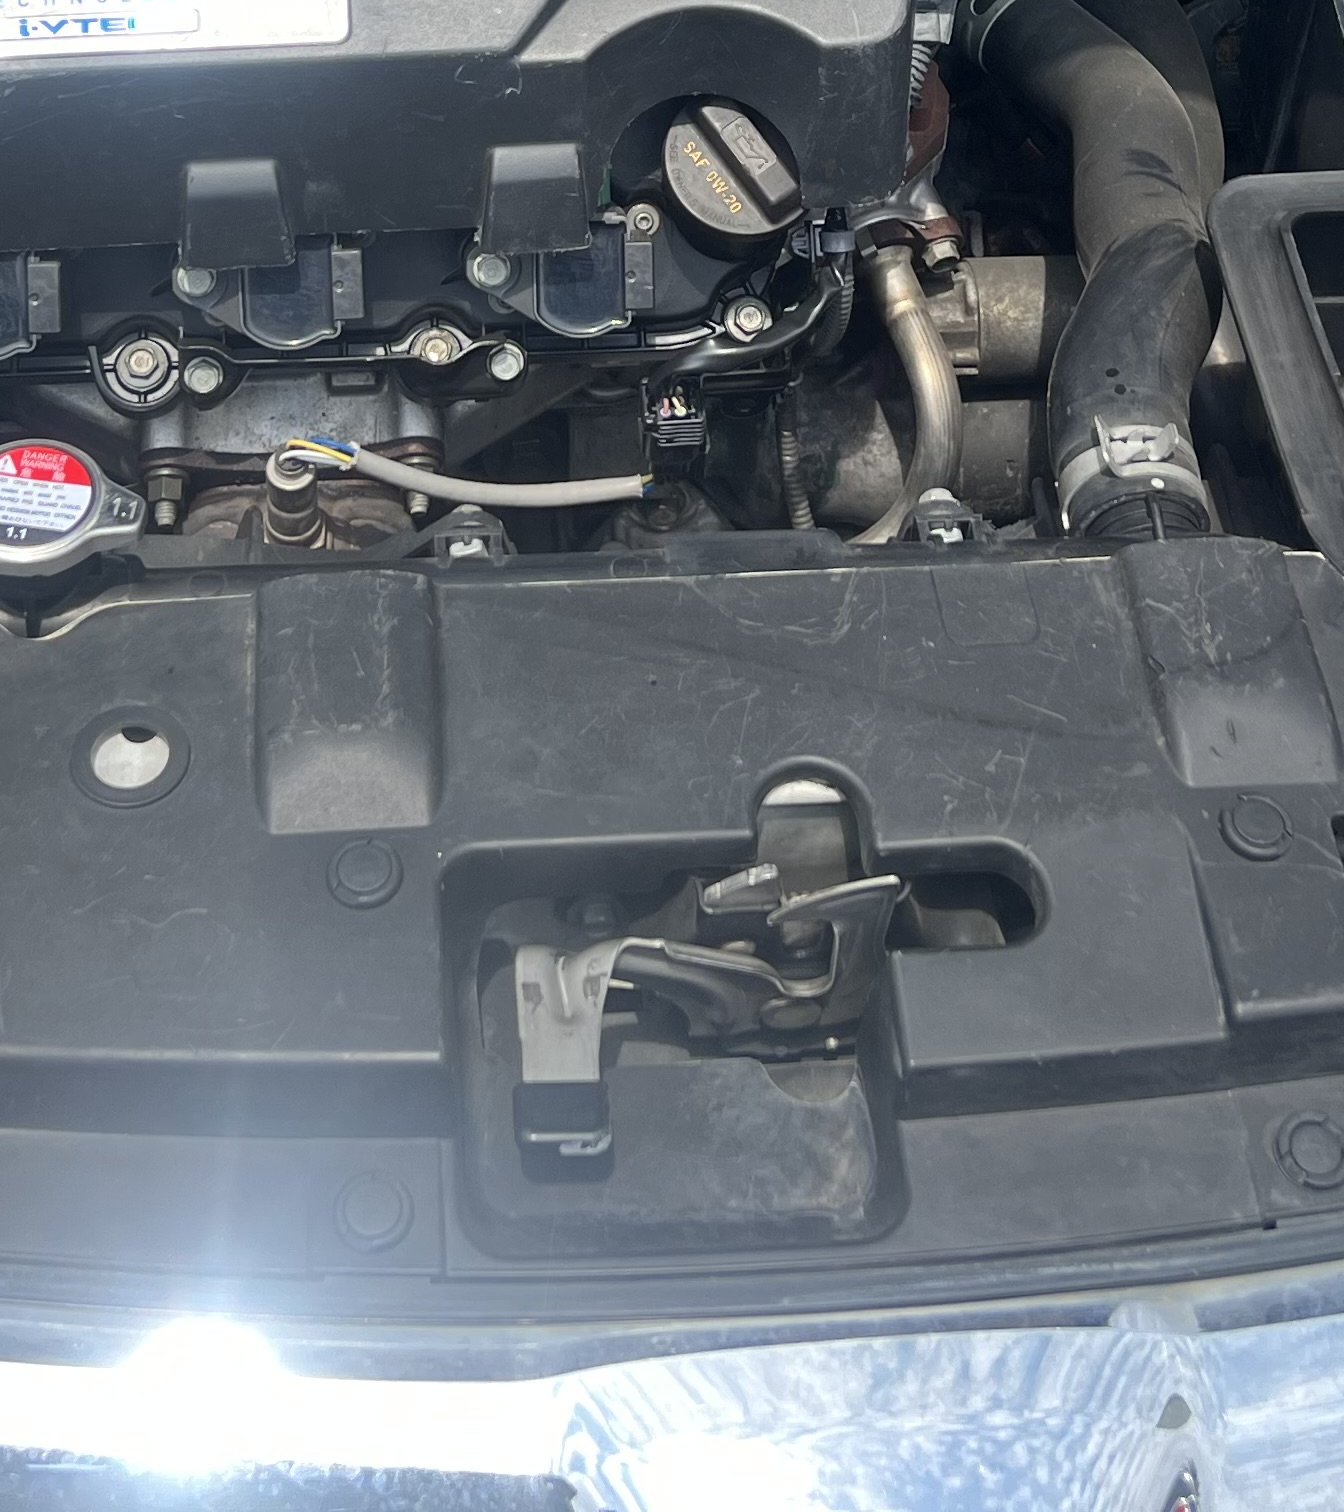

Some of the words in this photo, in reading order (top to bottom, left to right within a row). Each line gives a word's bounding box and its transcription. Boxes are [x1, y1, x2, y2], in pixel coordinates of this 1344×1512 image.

[19, 17, 136, 37] i-VTE
[22, 450, 68, 462] DANGER
[20, 458, 65, 472] WARNING
[113, 497, 138, 520] 1.1
[6, 526, 27, 540] 1.1
